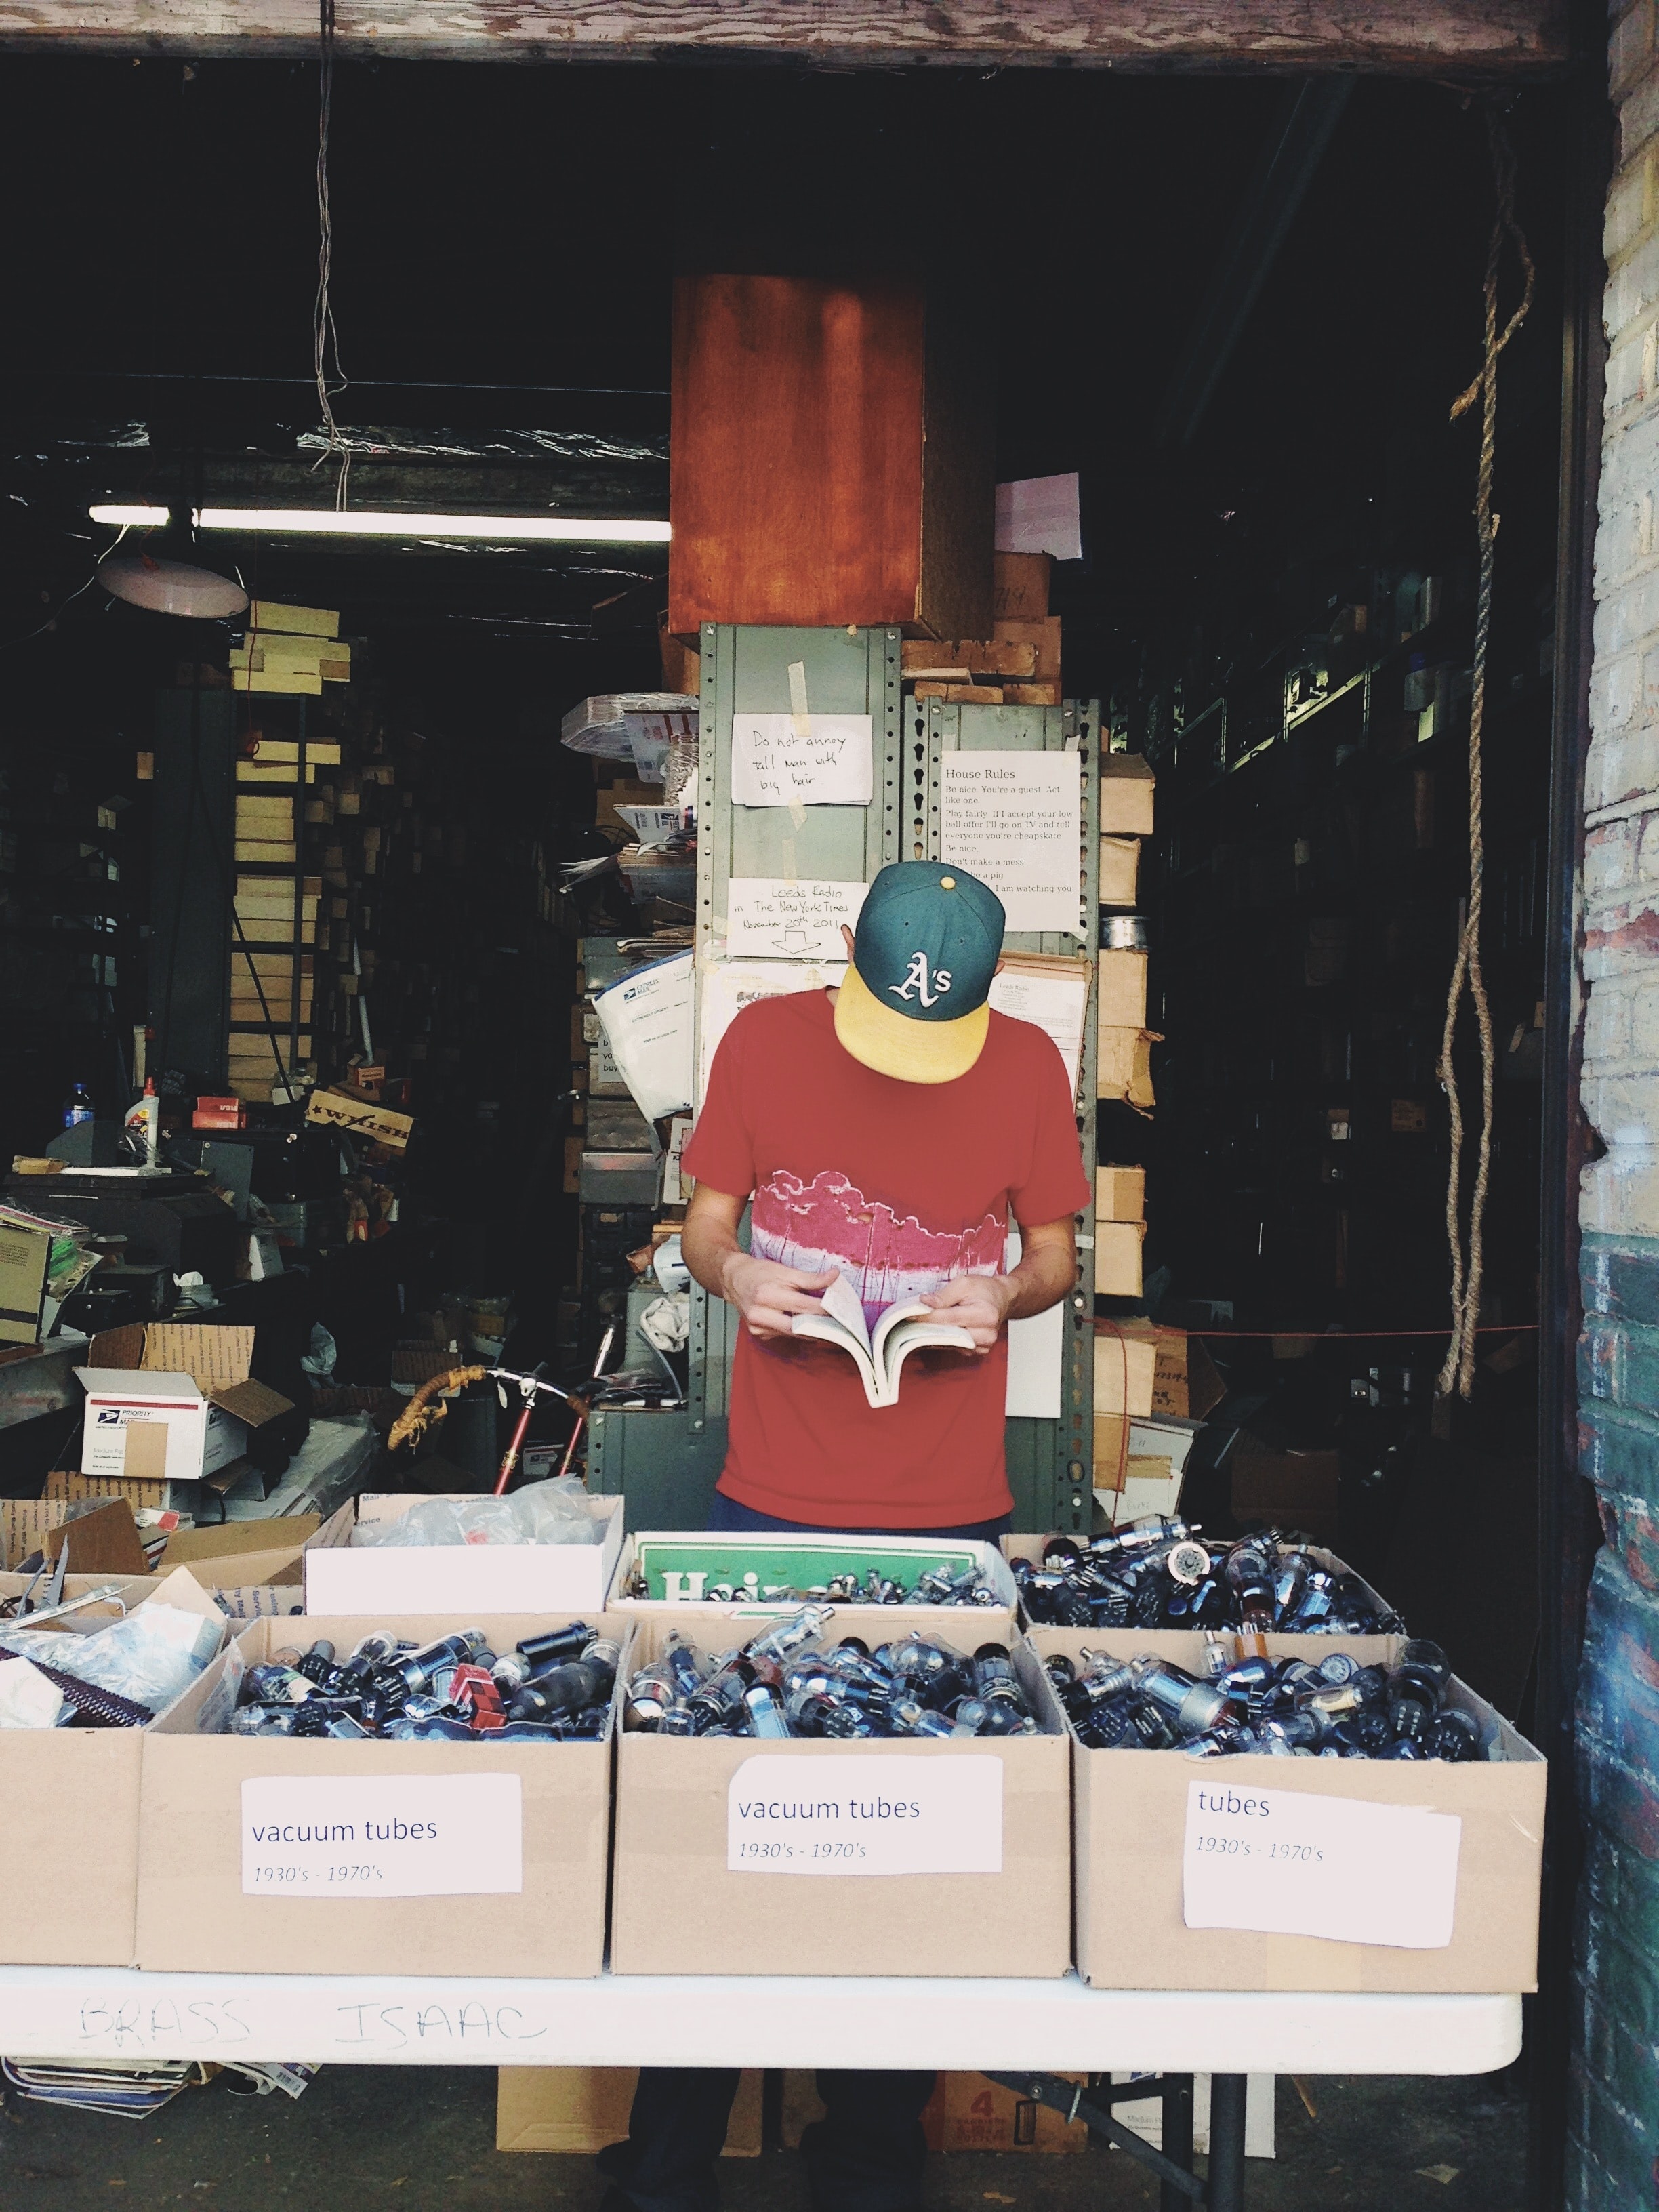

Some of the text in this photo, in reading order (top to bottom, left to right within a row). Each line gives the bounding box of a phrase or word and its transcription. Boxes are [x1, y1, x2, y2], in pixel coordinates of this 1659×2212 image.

[753, 731, 846, 752] Do not annoy
[753, 752, 836, 769] tall man with
[946, 769, 1015, 779] House Rules
[760, 773, 815, 795] big hair
[946, 810, 962, 819] Play
[1007, 811, 1034, 819] accept
[771, 885, 842, 898] Leeds Radio
[1017, 884, 1054, 893] watching
[754, 901, 775, 912] The
[780, 901, 798, 912] New
[800, 901, 821, 913] York
[823, 901, 848, 912] Times
[743, 916, 838, 930] November 20th 2011
[888, 951, 951, 1008] A's
[738, 1796, 920, 1819] vacuum tubes
[1198, 1790, 1270, 1817] tubes
[251, 1817, 438, 1842] vacuum tubes
[738, 1843, 794, 1858] 1930's
[811, 1843, 867, 1858] 1970's
[1195, 1836, 1250, 1856] 1930's
[1269, 1843, 1324, 1862] 1970's
[254, 1866, 308, 1882] 1930's
[327, 1865, 383, 1881] 1970's
[335, 2001, 548, 2049] ISAAC
[970, 2091, 994, 2117] 4
